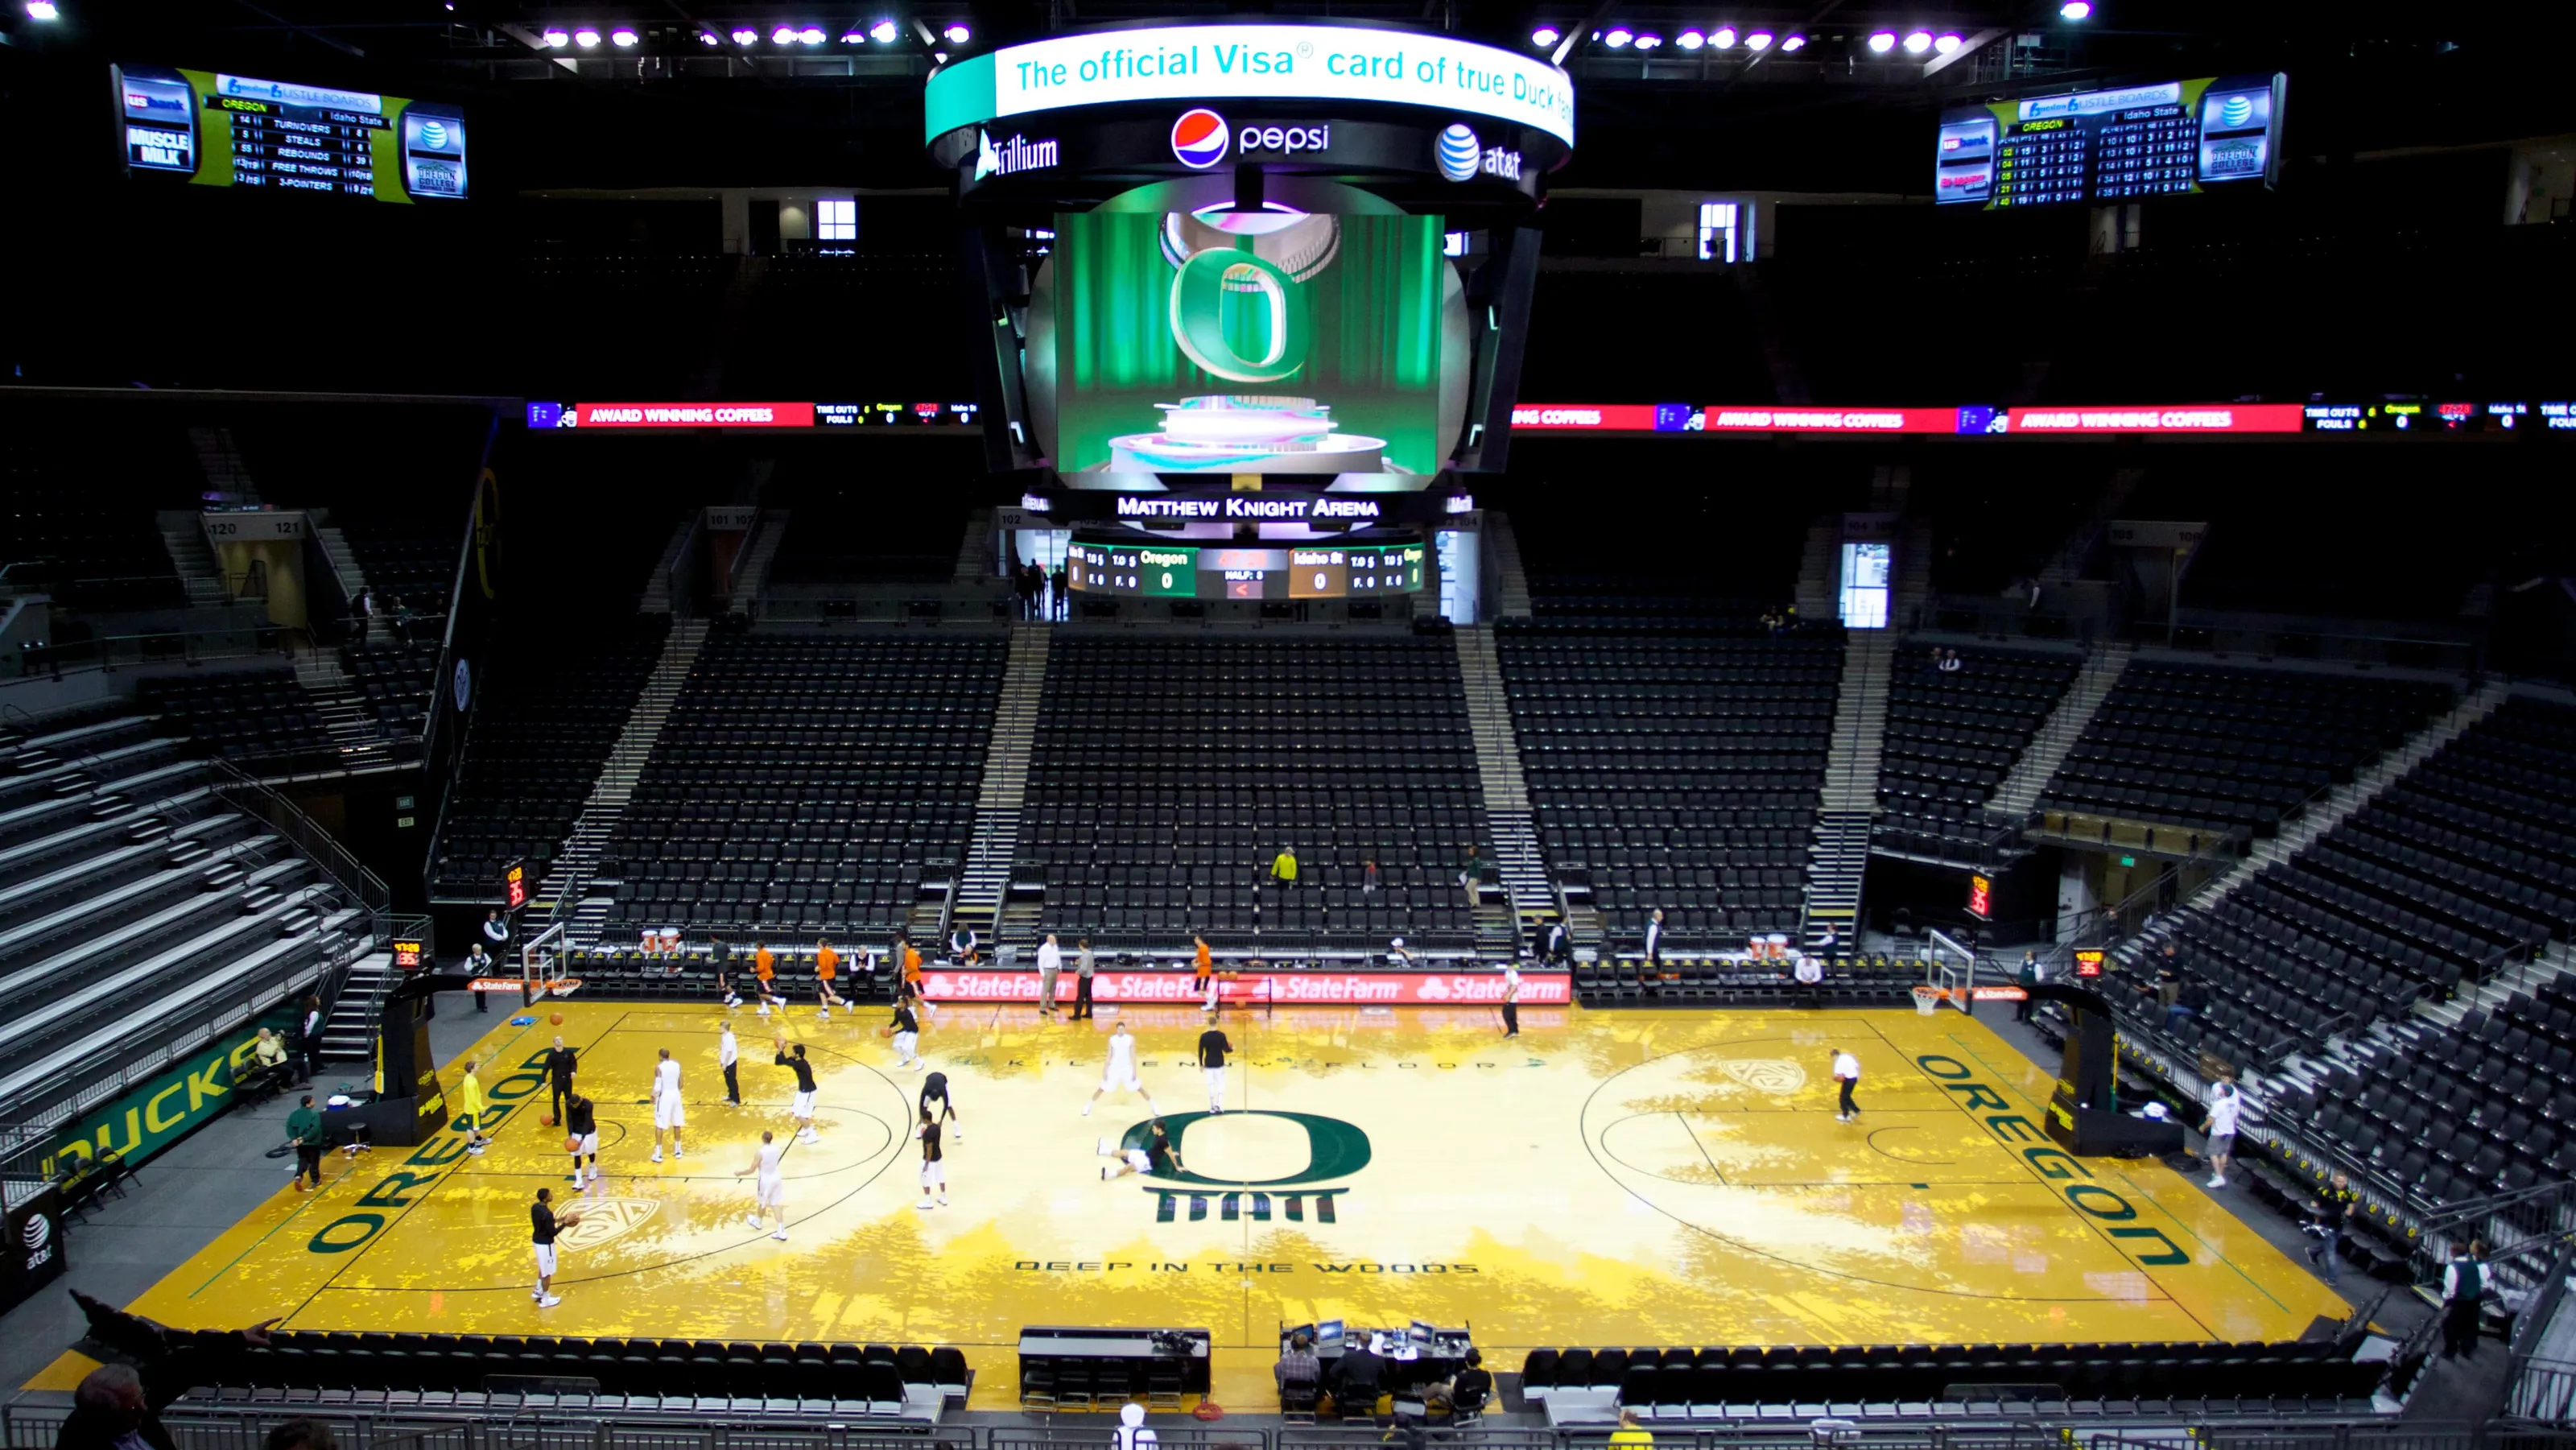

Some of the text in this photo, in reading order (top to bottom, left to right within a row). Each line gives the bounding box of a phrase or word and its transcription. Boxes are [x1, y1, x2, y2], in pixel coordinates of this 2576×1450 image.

[1018, 60, 1067, 90] The
[1080, 45, 1197, 81] official
[1327, 52, 1403, 79] card
[1417, 57, 1446, 85] of
[1456, 61, 1504, 95] true
[1514, 72, 1554, 109] Duck
[323, 93, 371, 107] BOARDS
[2118, 89, 2169, 105] BOARDS
[221, 98, 267, 113] OREGON
[331, 112, 383, 126] Idaho State
[2124, 106, 2178, 121] Idaho State
[240, 115, 250, 124] 14
[274, 120, 331, 134] TURNOVERS
[2022, 120, 2063, 132] OREGON
[130, 128, 188, 150] MUSCLE
[285, 134, 321, 147] STEALS
[1240, 125, 1328, 154] pepsi
[2107, 135, 2136, 145] 10 10
[141, 147, 180, 166] MILK
[278, 148, 330, 161] REBOUNDS
[993, 134, 1058, 176] Trillium
[2125, 147, 2135, 155] 10
[272, 163, 297, 173] FREE
[299, 164, 338, 177] THROWS
[1485, 147, 1521, 180] at&t
[279, 178, 333, 192] 3-POINTERS
[589, 408, 774, 423] AWARD WINNING COFFEES
[816, 405, 858, 414] TIME OUTS
[2305, 407, 2360, 418] TIME OUTS
[2489, 405, 2514, 414] Idaho
[2540, 405, 2568, 415] TIME
[826, 415, 853, 423] FOULS
[886, 412, 894, 423] 0
[960, 412, 968, 423] 0
[1541, 410, 1602, 424] COFFEES
[1717, 411, 1904, 428] AWARD WINNING COFFEES
[2020, 411, 2231, 428] AWARD WINNING COFFEES
[2317, 419, 2352, 429] FOULS
[2396, 415, 2408, 428] 0
[2501, 415, 2513, 428] 0
[2549, 418, 2576, 428] FOU
[1117, 497, 1380, 517] MATTHEW KNIGHT ARENA
[711, 515, 729, 525] 101
[1001, 515, 1022, 524] 102
[211, 522, 299, 535] 120 121
[1141, 550, 1188, 568] Oregon
[1294, 551, 1344, 565] Idaho St
[1129, 576, 1137, 589] 0
[1162, 572, 1173, 589] 0
[1314, 572, 1327, 590] 0
[1367, 576, 1375, 589] 0
[509, 881, 524, 907] 35
[1971, 887, 1988, 915] 35
[394, 943, 420, 953] 47:28
[398, 952, 417, 965] 35
[2080, 961, 2099, 977] 35
[483, 981, 521, 990] StateFarm
[1289, 976, 1402, 1000] StateFarm
[1452, 977, 1563, 1000] Statearm
[1009, 1060, 1272, 1068] KILENY
[1917, 1055, 2190, 1266] OREGON
[27, 1244, 52, 1270] at&t
[1015, 1261, 1479, 1274] DEEP IN THE WOODS
